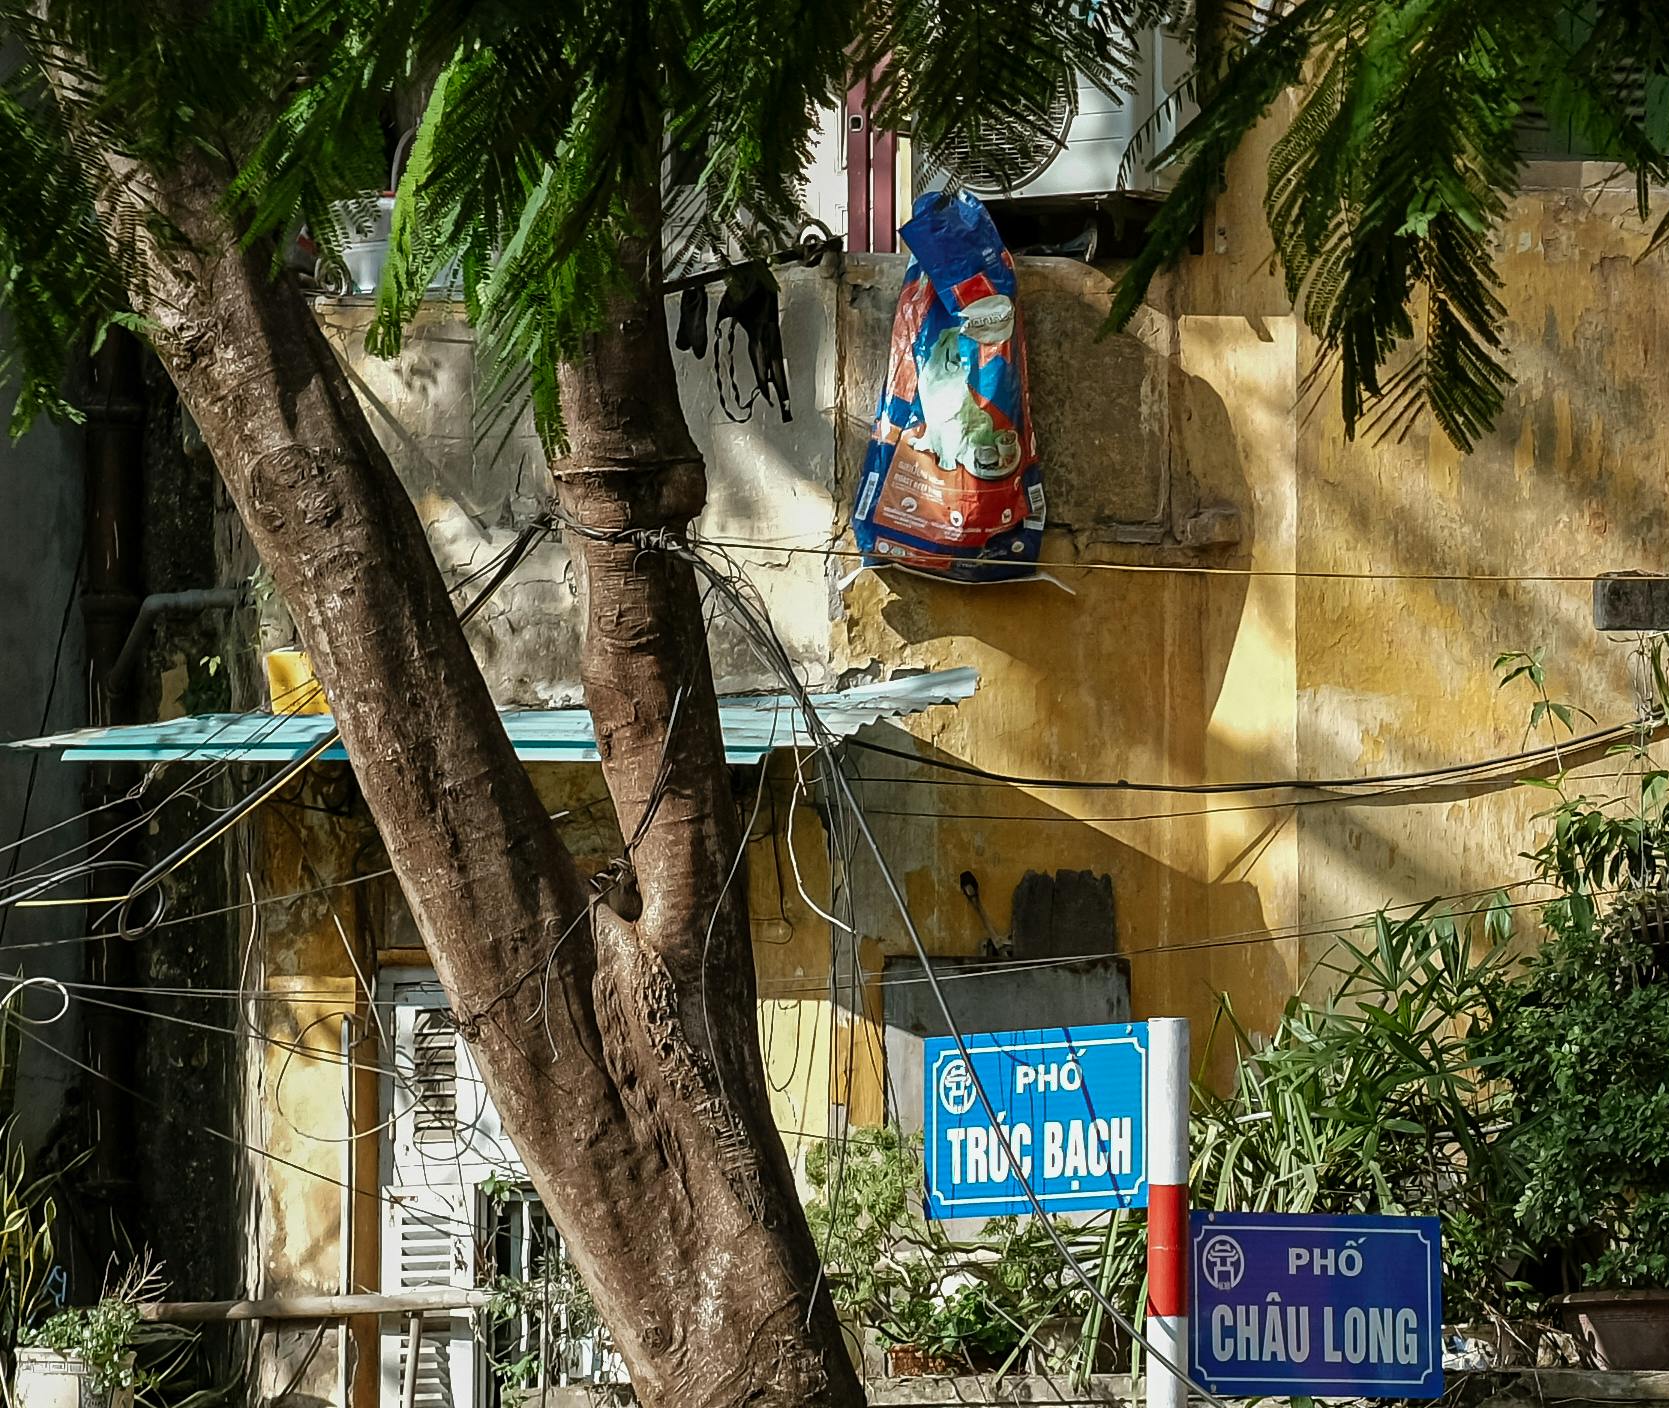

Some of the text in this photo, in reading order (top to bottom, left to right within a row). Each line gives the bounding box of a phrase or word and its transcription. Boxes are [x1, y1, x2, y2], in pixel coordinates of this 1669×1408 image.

[1016, 1048, 1086, 1094] PHỐ
[947, 1110, 1132, 1191] TRÚC BẠCH
[1288, 1236, 1366, 1278] PHỐ
[1212, 1292, 1418, 1365] CHÂU LONG
